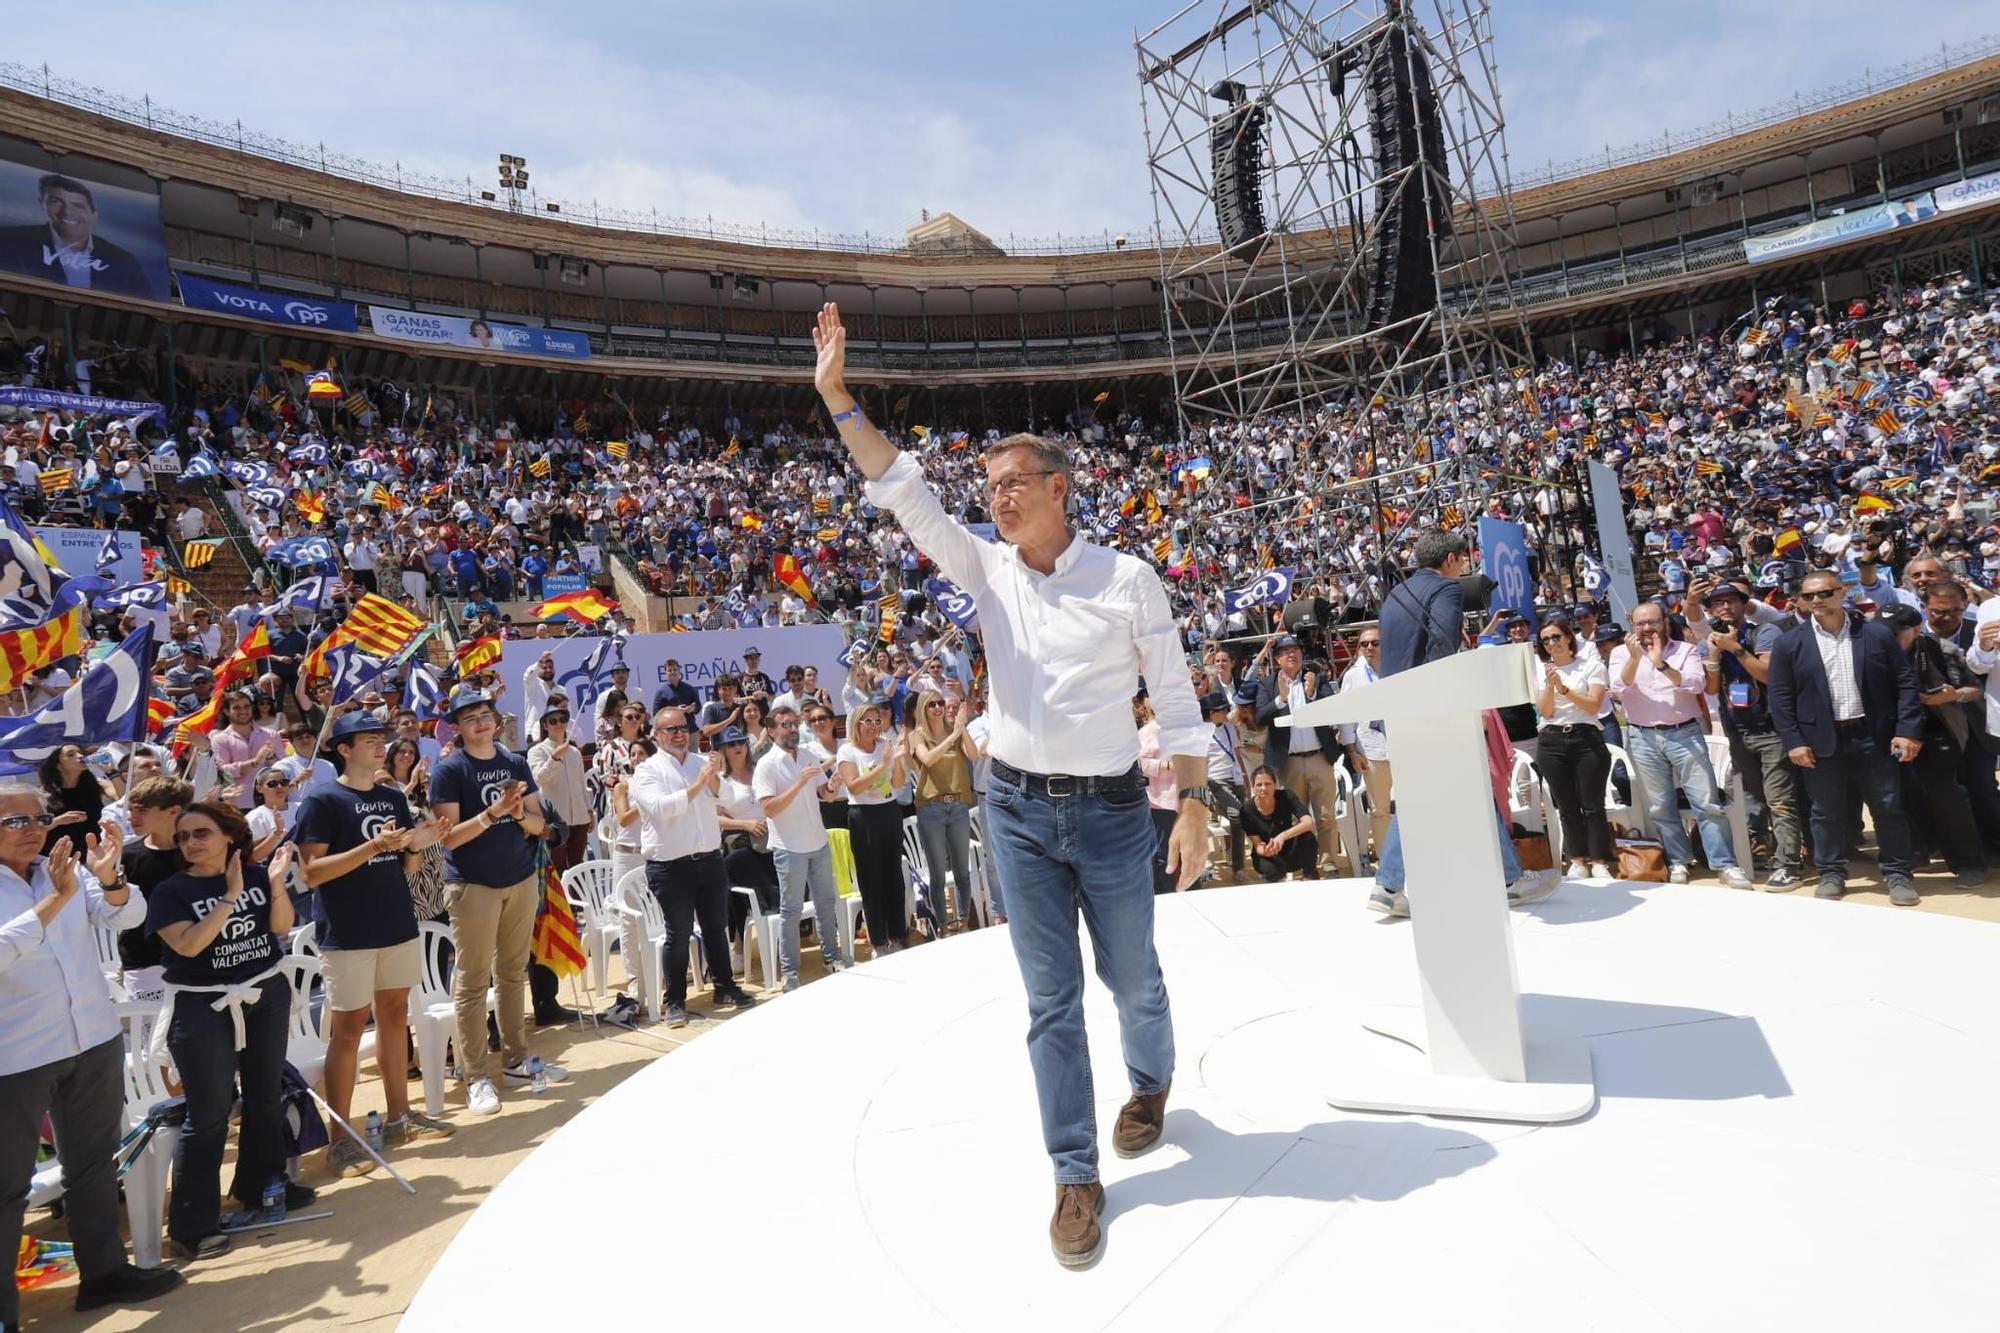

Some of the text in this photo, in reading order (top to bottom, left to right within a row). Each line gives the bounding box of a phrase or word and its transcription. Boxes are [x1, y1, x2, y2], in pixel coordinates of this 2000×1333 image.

[1762, 236, 1807, 252] CAMBIO
[213, 291, 274, 314] VOTA
[403, 326, 454, 339] VOTAR!
[152, 463, 179, 471] ELDA
[61, 540, 97, 548] ENTRE
[657, 657, 742, 683] EPAÑA
[476, 768, 512, 783] EQUIPO
[354, 800, 395, 814] EQUIPO
[191, 886, 267, 920] EQIPO
[214, 933, 269, 957] COMUNITAT
